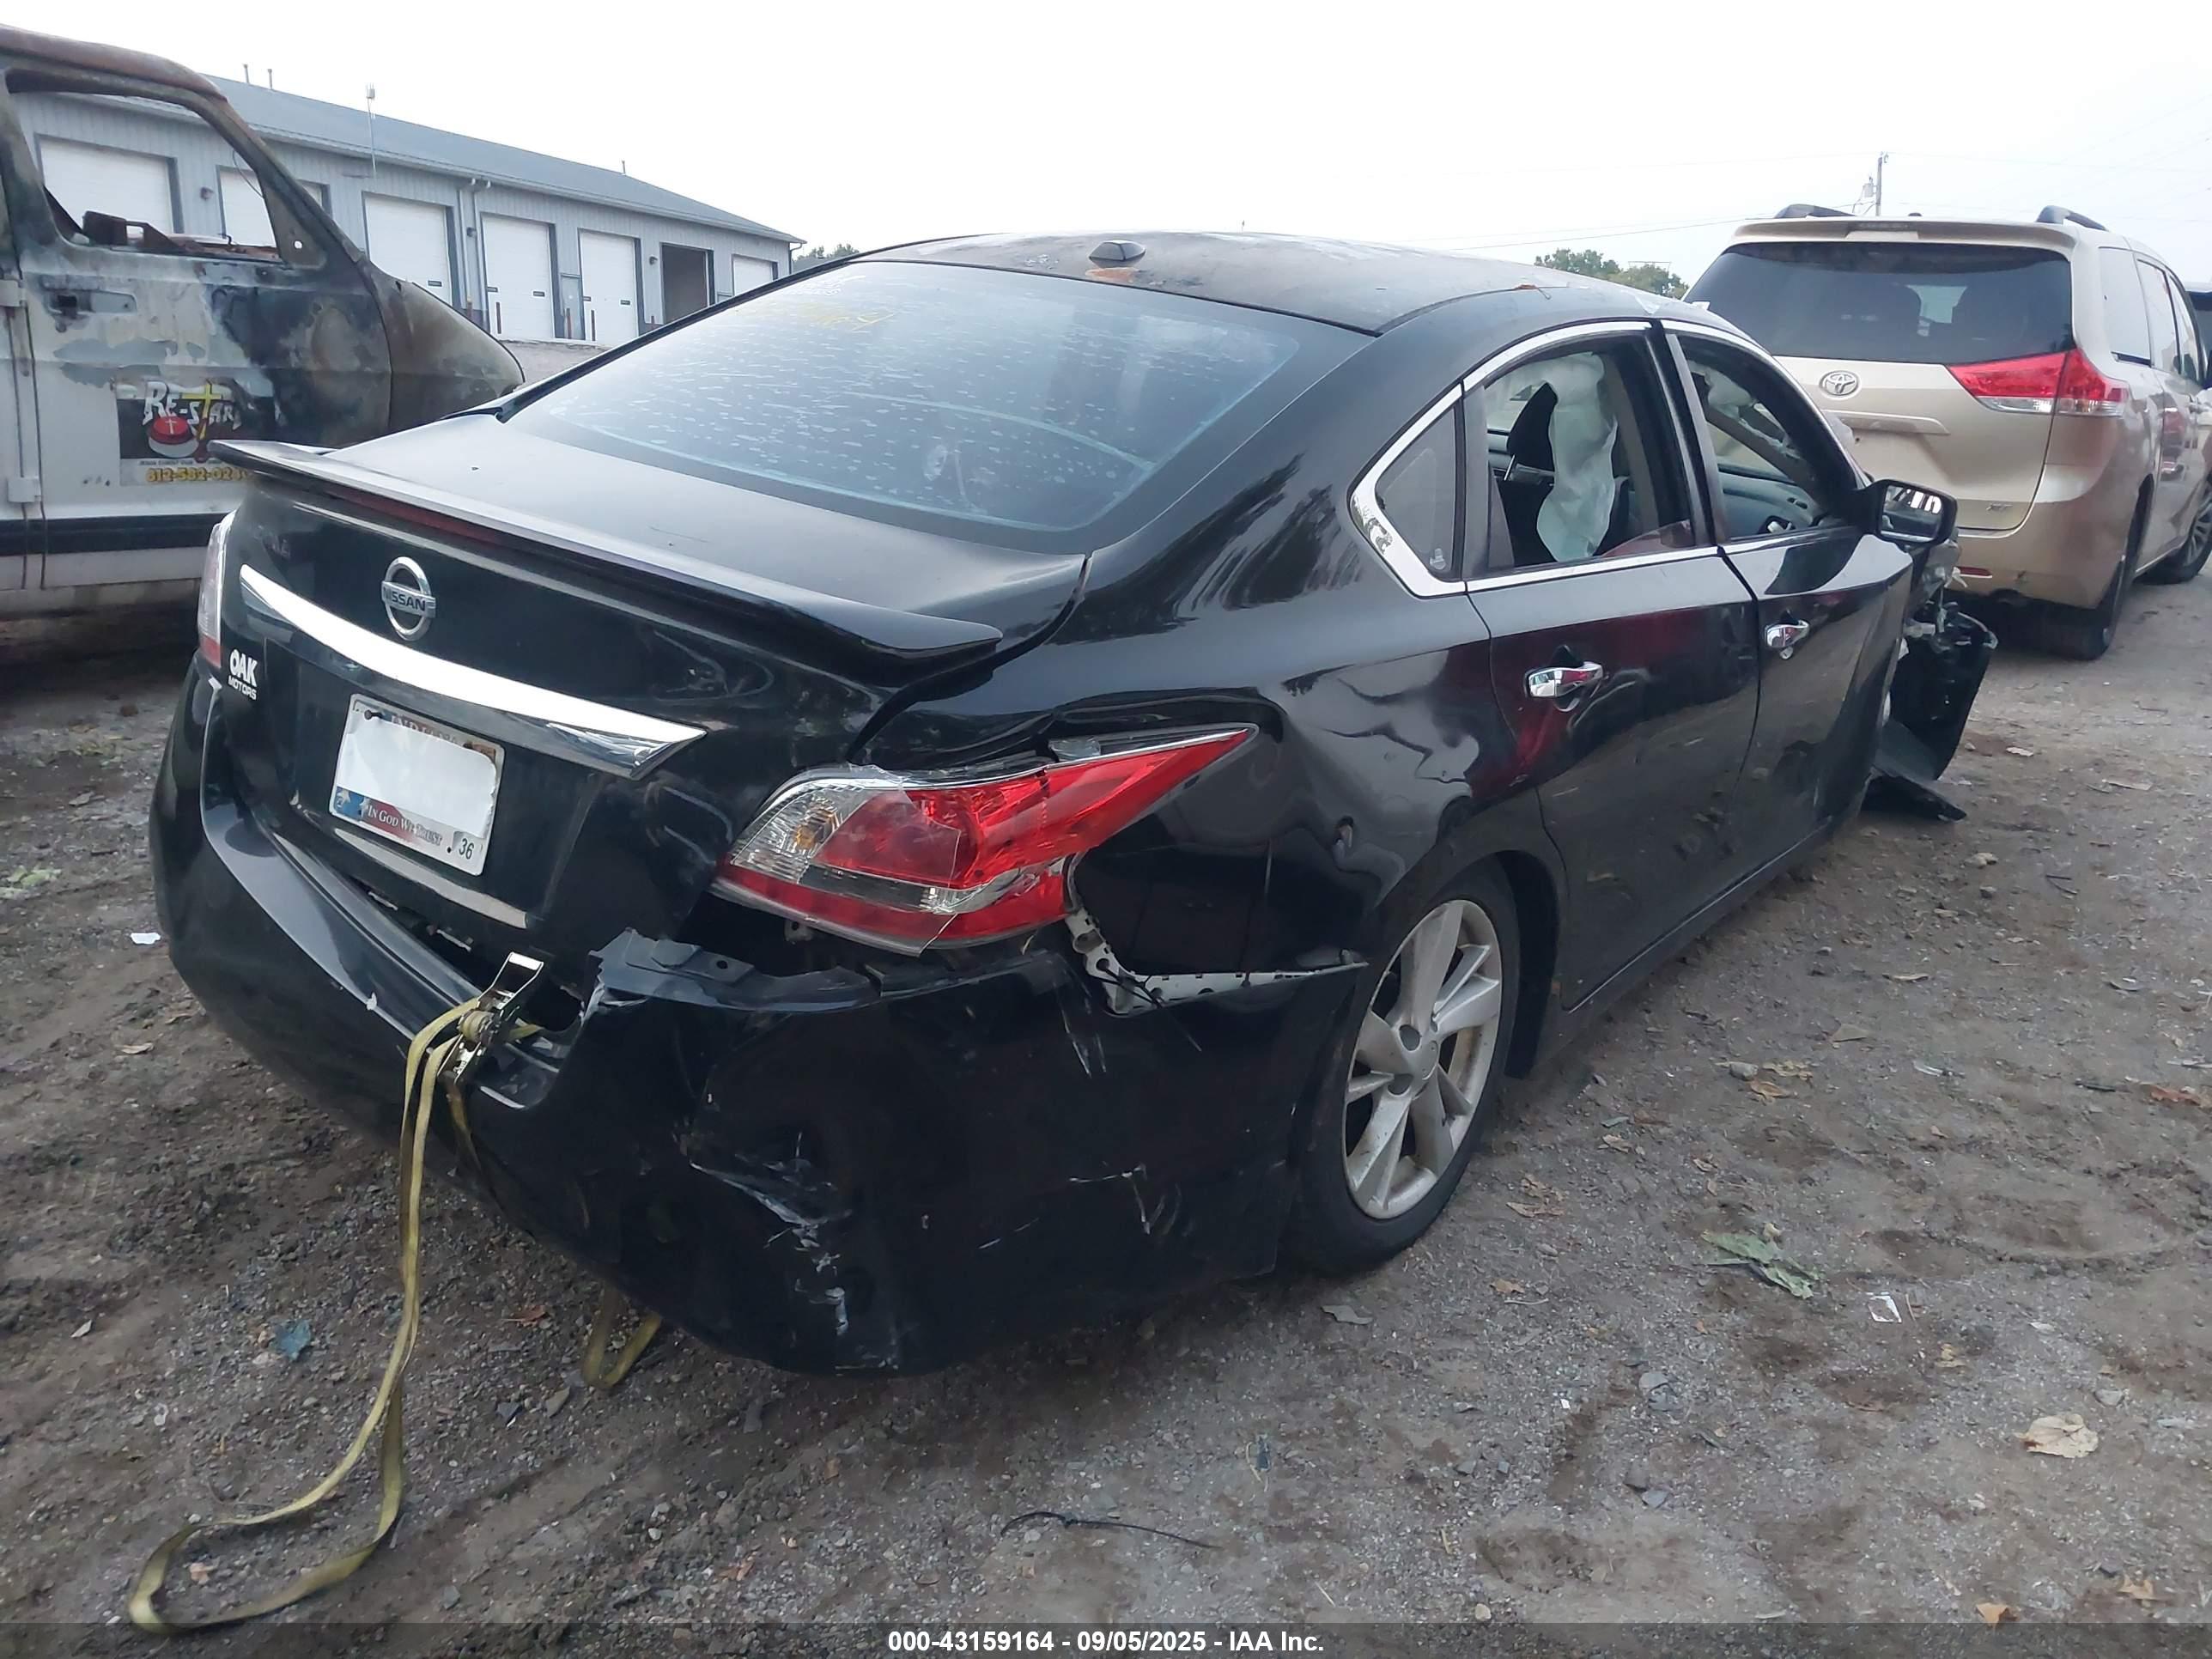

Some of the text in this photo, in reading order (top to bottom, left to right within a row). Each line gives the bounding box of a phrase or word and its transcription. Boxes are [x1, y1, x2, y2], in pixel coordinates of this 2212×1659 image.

[229, 649, 258, 687] OAK
[228, 675, 257, 701] MOTORS
[368, 805, 378, 818] IN
[379, 809, 399, 828] GOD
[415, 823, 443, 847] TRUST
[459, 837, 475, 860] 36
